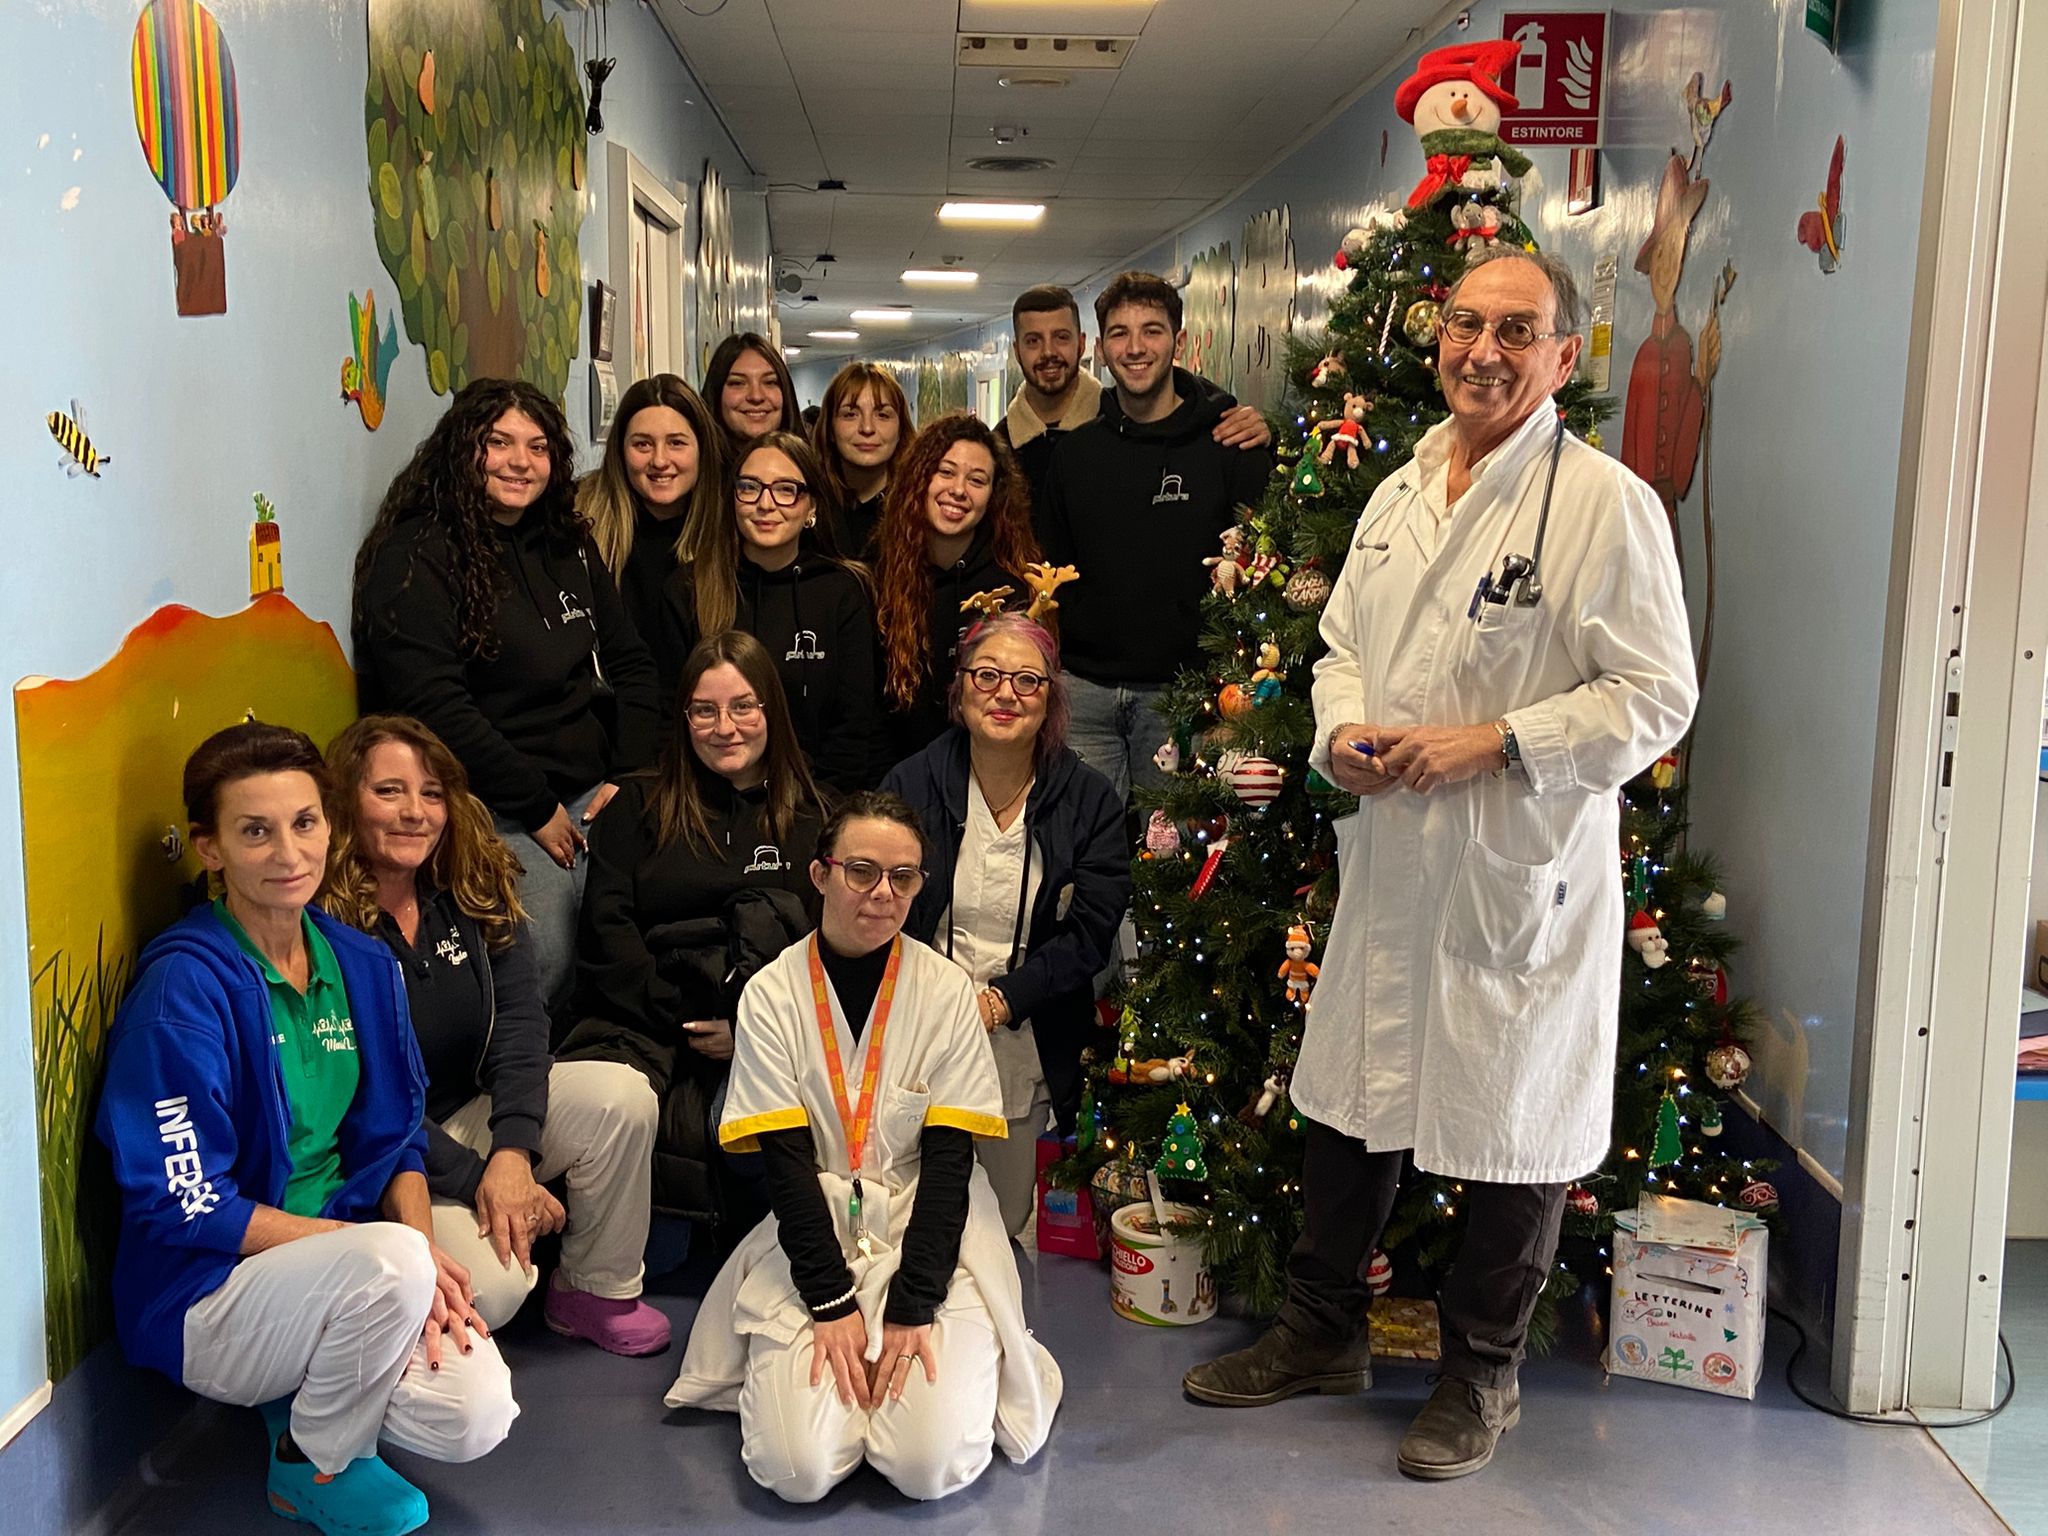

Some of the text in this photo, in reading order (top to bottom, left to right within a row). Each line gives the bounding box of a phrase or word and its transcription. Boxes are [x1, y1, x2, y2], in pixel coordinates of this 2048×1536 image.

[1511, 127, 1583, 138] ESTINTORE
[1292, 577, 1324, 590] SENZA
[1635, 1291, 1713, 1319] LETTERINE
[1667, 1310, 1677, 1319] DI
